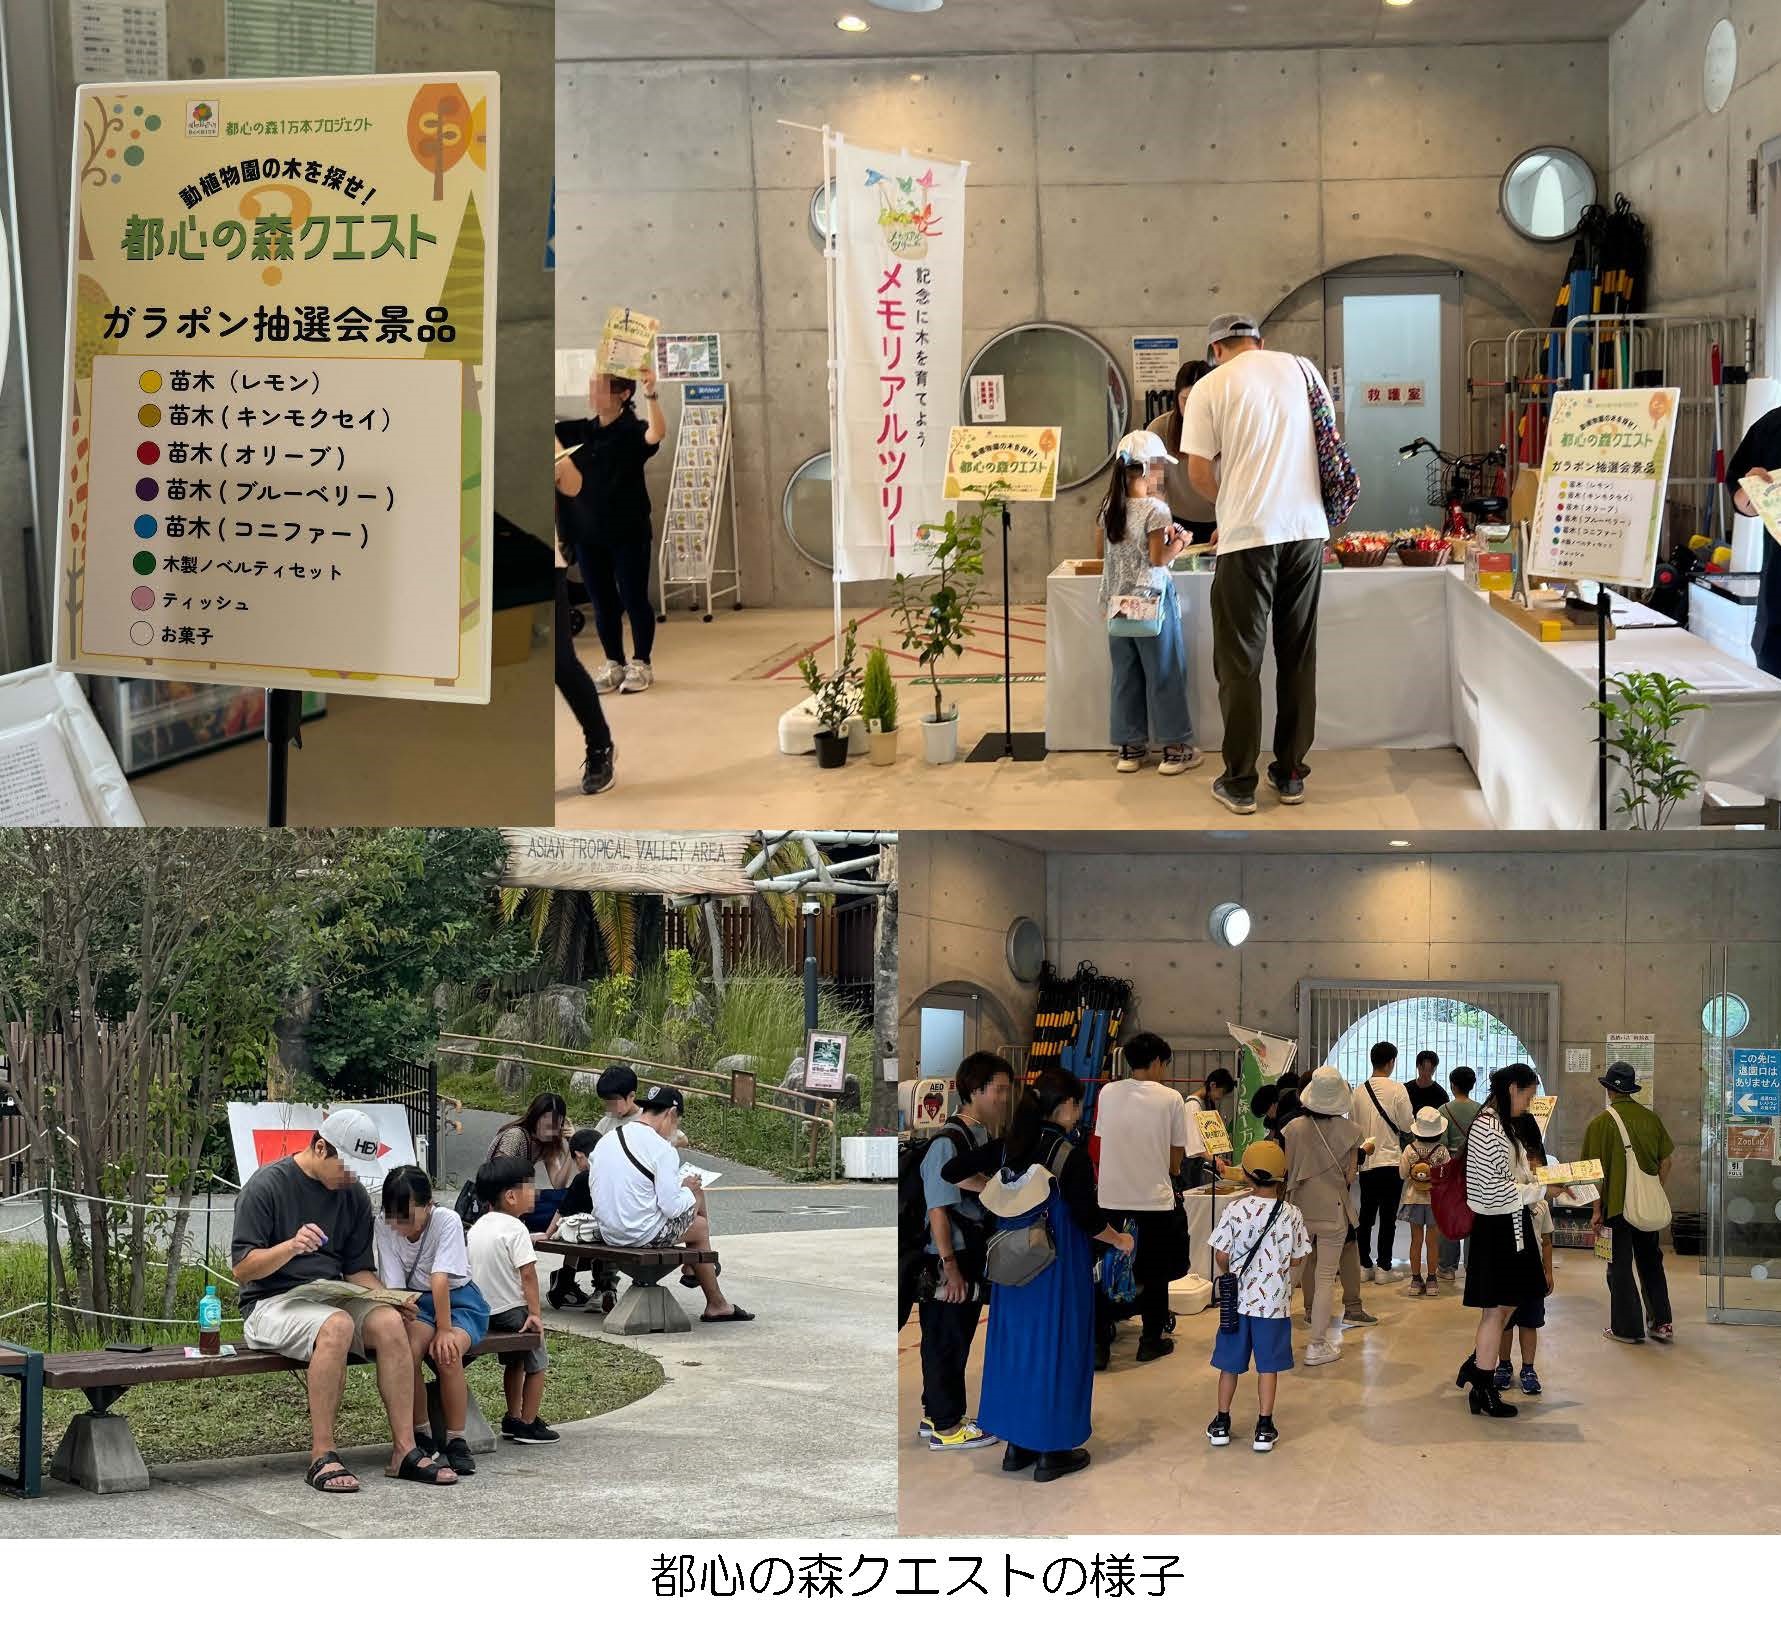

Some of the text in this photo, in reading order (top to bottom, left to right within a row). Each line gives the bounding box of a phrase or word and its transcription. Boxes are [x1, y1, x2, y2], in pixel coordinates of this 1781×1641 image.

[226, 117, 374, 136] 都心の森1万本プロジェクト
[179, 157, 377, 209] 動植物園の木を探せ!
[120, 213, 438, 261] 都心の森クエスト
[102, 304, 457, 344] ガラポン抽選会景品
[914, 266, 932, 449] 記念に木を育てよう
[877, 262, 909, 558] メモリアルツリー
[162, 554, 342, 582] 木製ノベルティセット
[161, 592, 250, 613] ティッシュ
[161, 626, 214, 646] お菓子
[528, 837, 727, 864] ASIAN TROPICAL VALLEY AREA
[1740, 1052, 1777, 1064] この先に
[930, 1083, 945, 1091] AED
[1735, 1077, 1780, 1088] ありません
